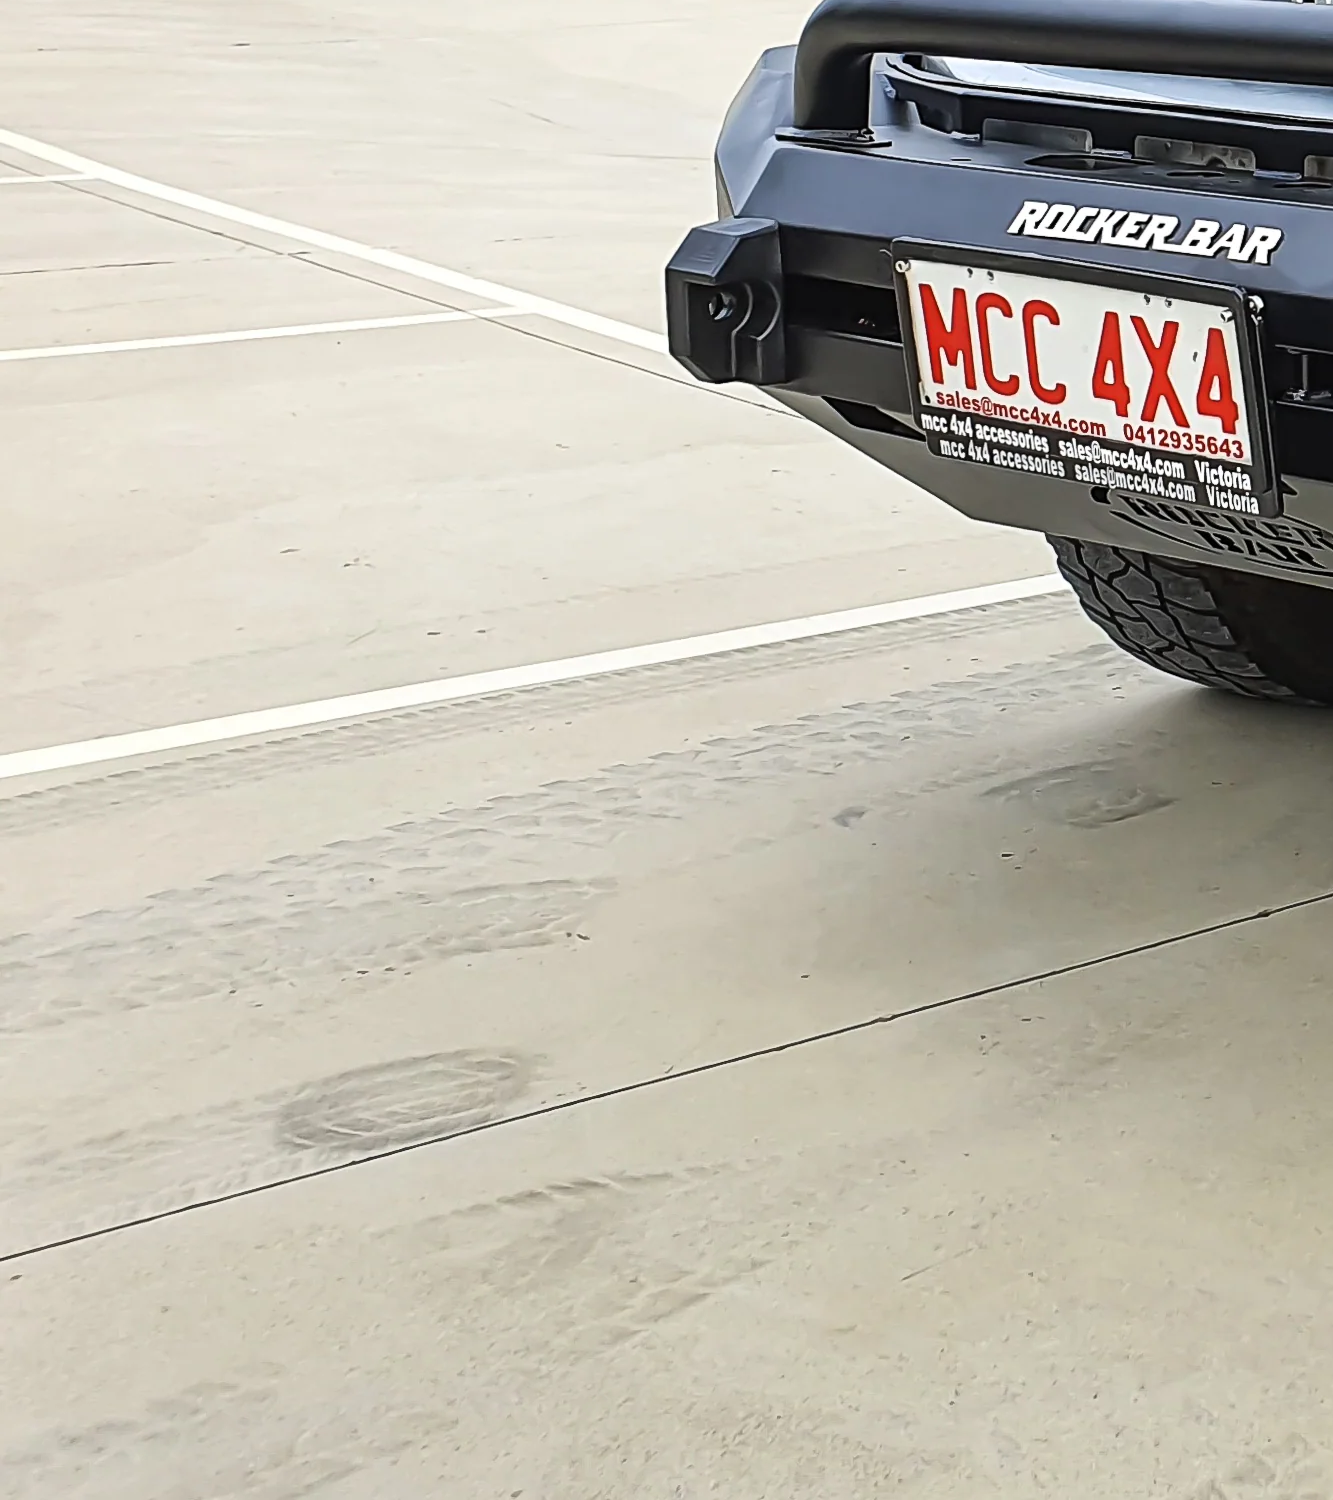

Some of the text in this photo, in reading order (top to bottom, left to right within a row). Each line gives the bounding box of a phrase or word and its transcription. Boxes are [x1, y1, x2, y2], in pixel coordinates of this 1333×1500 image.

[1007, 200, 1283, 264] ROCKER BAR
[918, 283, 1239, 435] MCC 4X4
[920, 413, 1251, 491] mcc 4x4 accessories sales@mcc4x4.com Victoria
[936, 391, 1244, 458] sales@mcc4x4.com 0412935643
[939, 439, 1260, 515] mcc 4x4 accessories sales@mcc4x4.com Victoria
